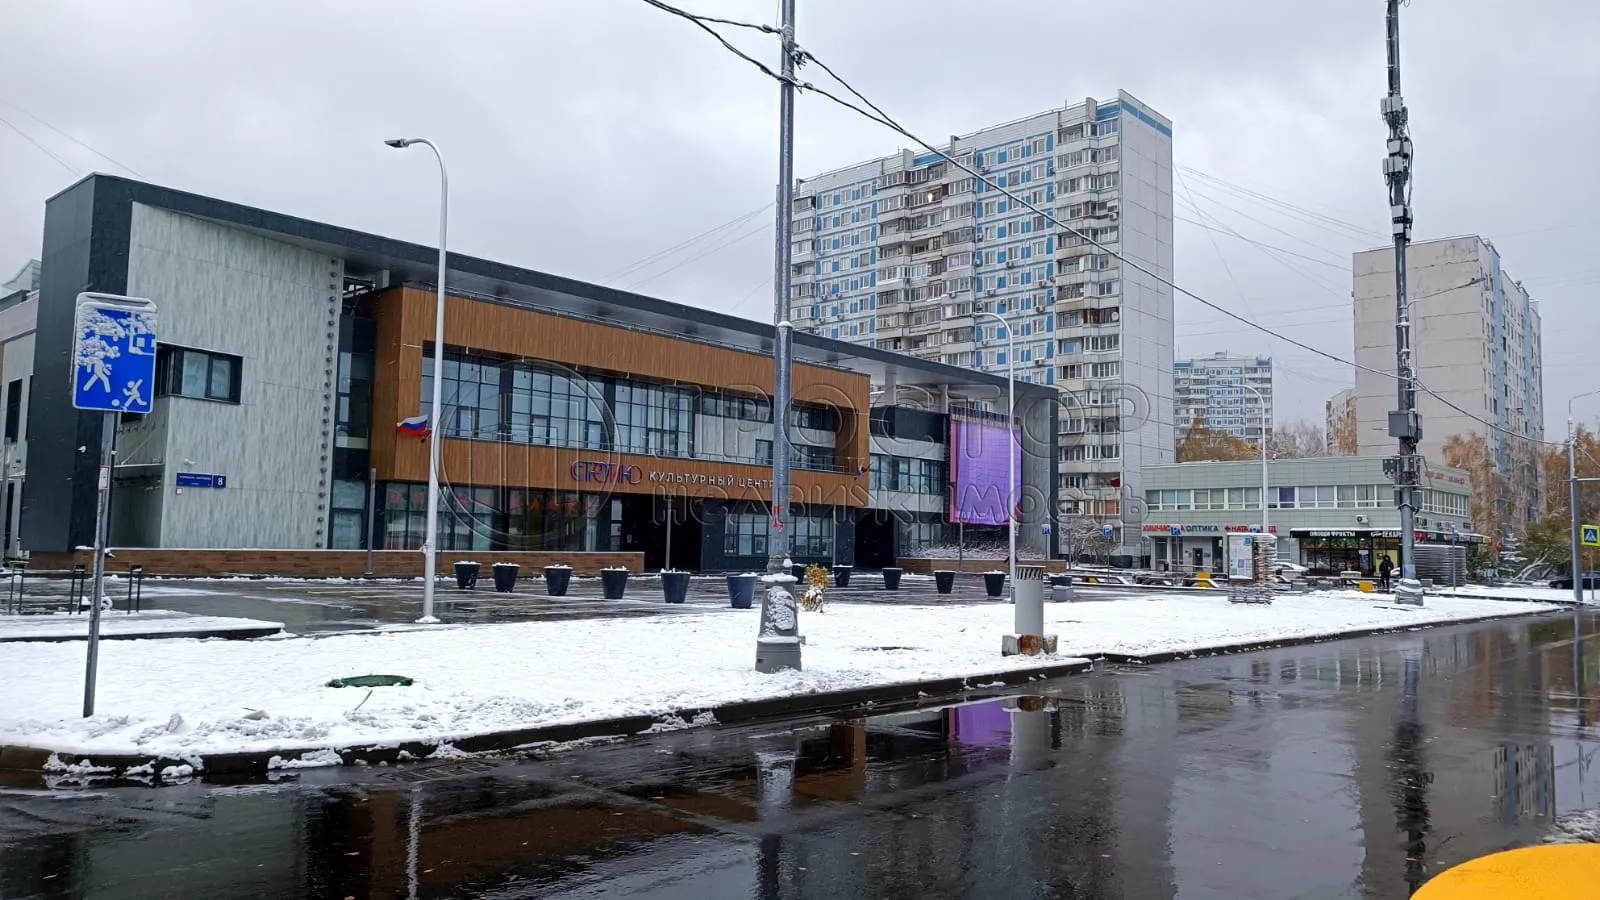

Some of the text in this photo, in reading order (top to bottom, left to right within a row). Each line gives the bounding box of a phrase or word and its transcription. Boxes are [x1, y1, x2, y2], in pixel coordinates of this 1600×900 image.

[217, 477, 223, 486] 8
[649, 471, 734, 486] КУЛЬТУРНЫЙ
[1186, 525, 1219, 533] ОПТИКА
